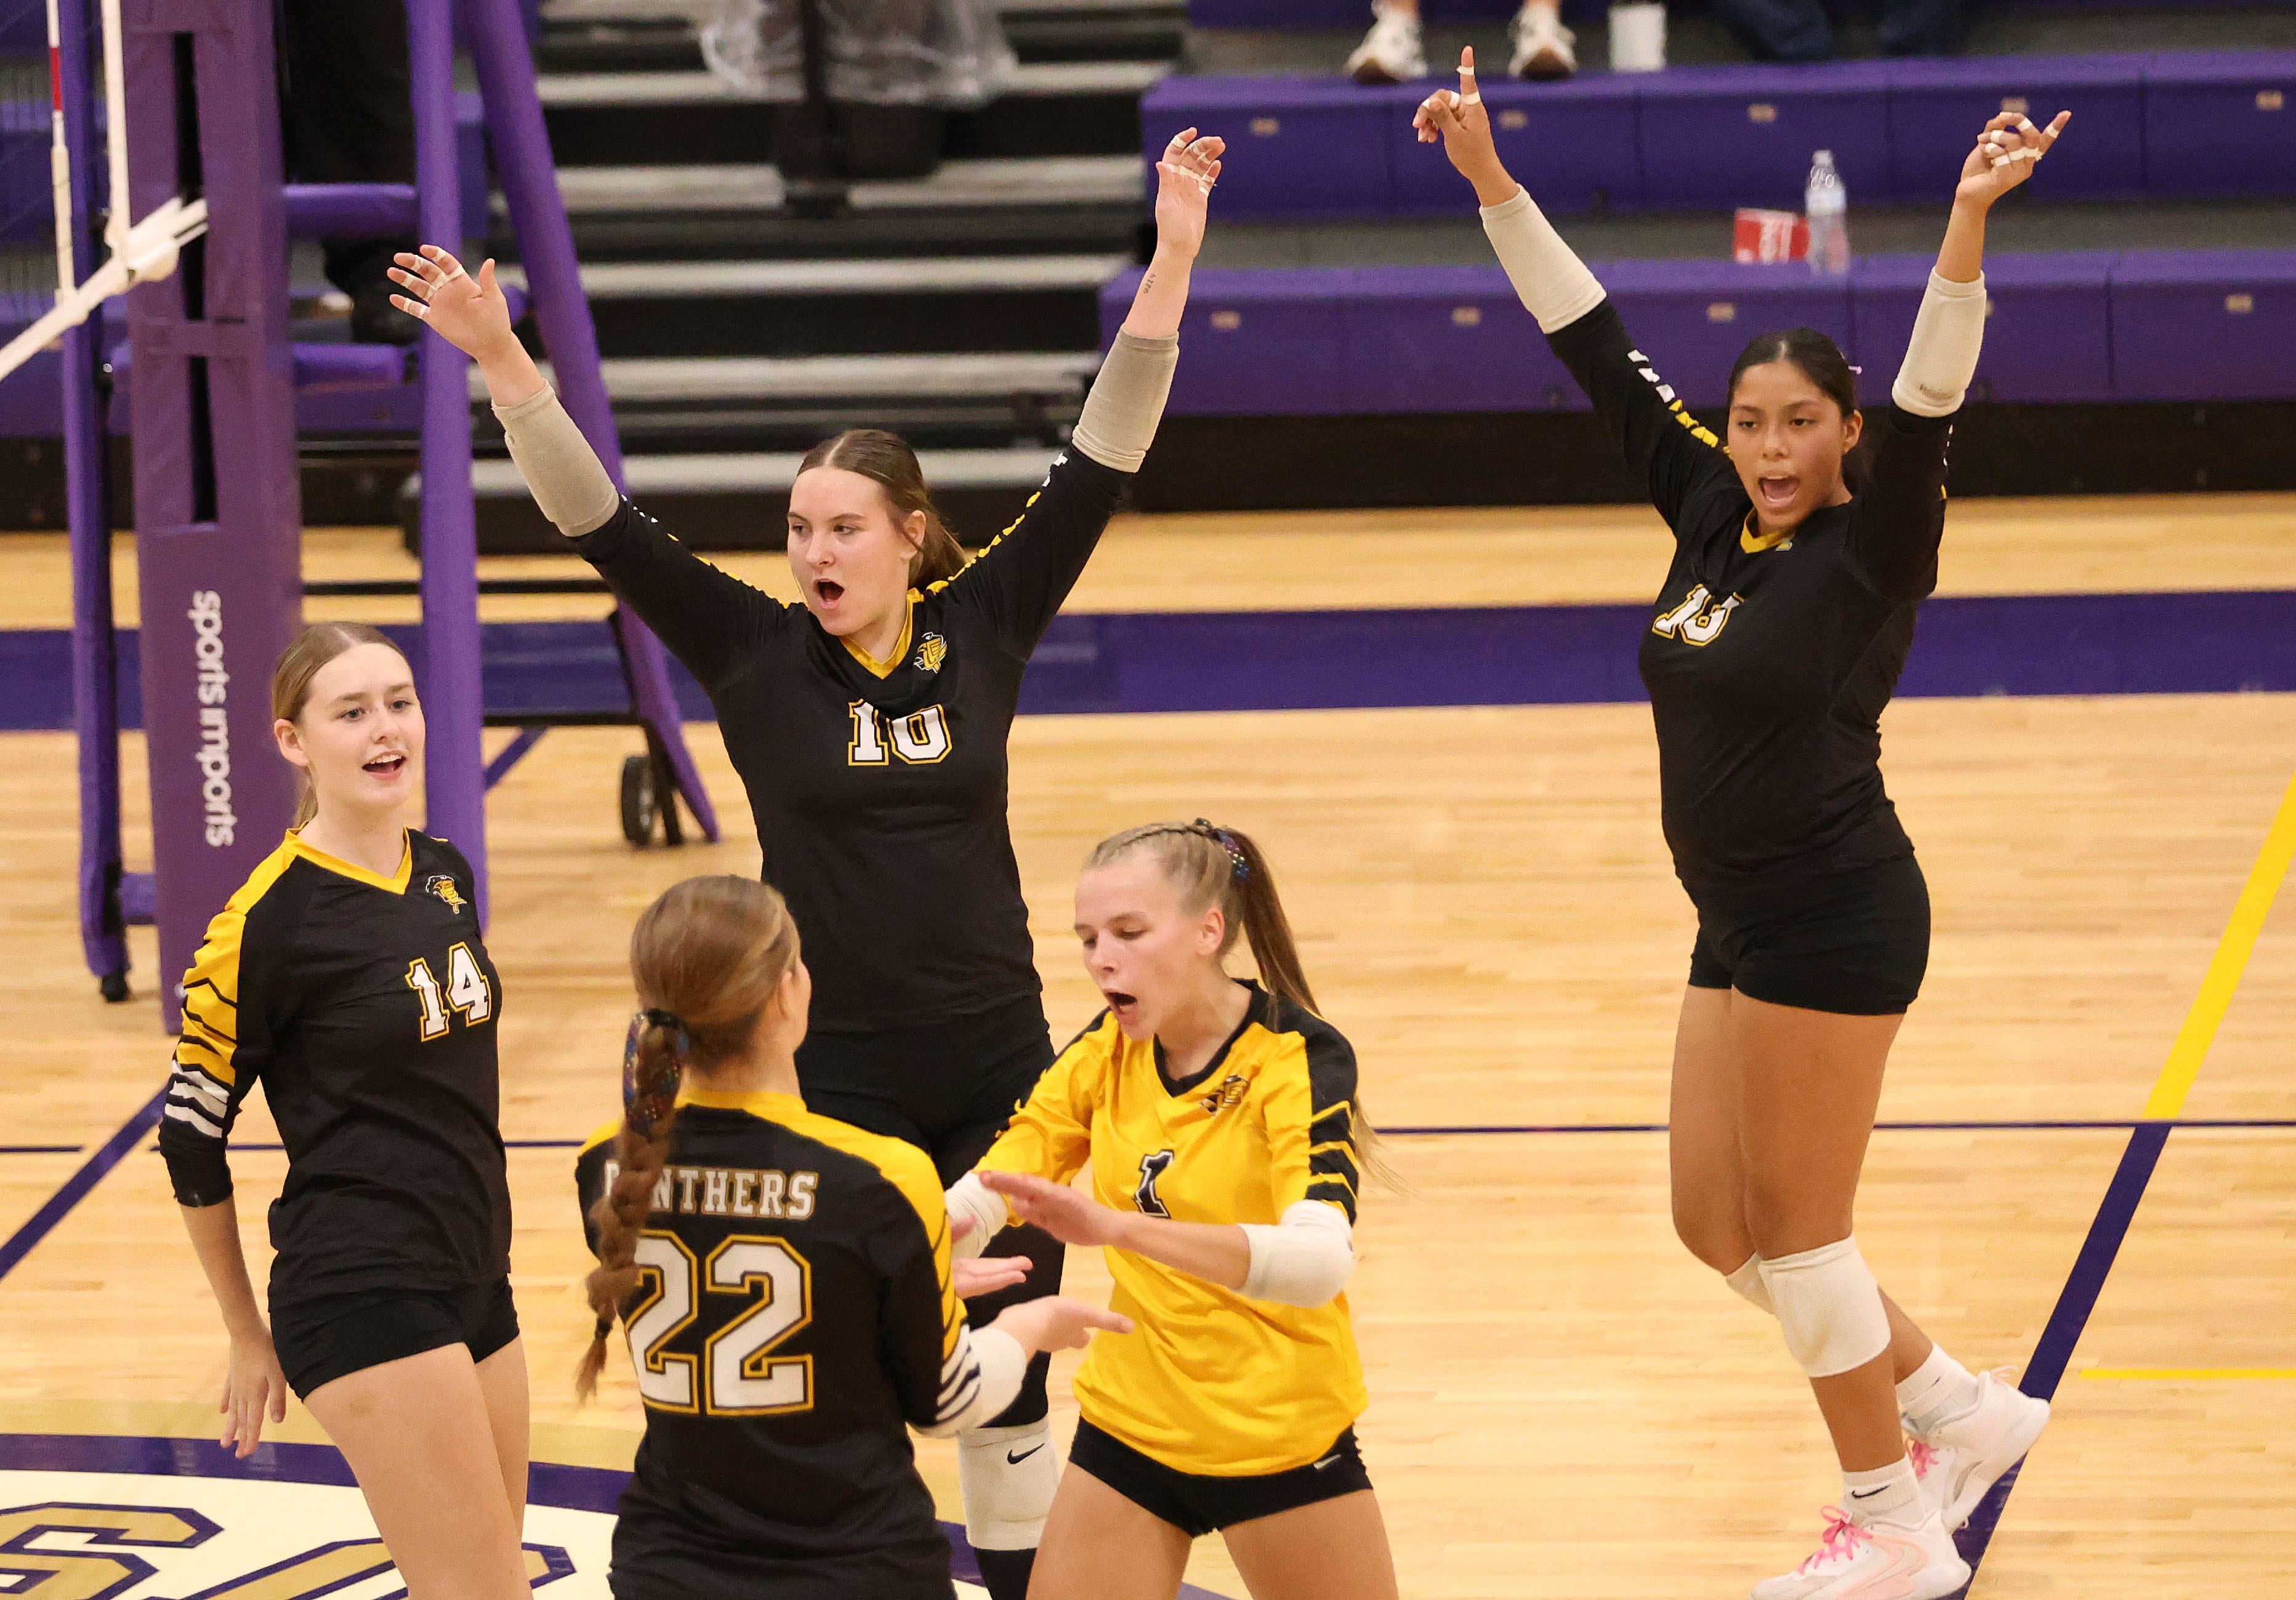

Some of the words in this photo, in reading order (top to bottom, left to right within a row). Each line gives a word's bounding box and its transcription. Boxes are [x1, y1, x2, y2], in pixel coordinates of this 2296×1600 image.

[189, 590, 230, 705] sports
[195, 708, 237, 848] imports
[848, 698, 953, 766] 10
[405, 941, 492, 1043] 14
[605, 1159, 820, 1221] PNTHERS
[1133, 1149, 1175, 1219] 1
[624, 1229, 815, 1417] 22
